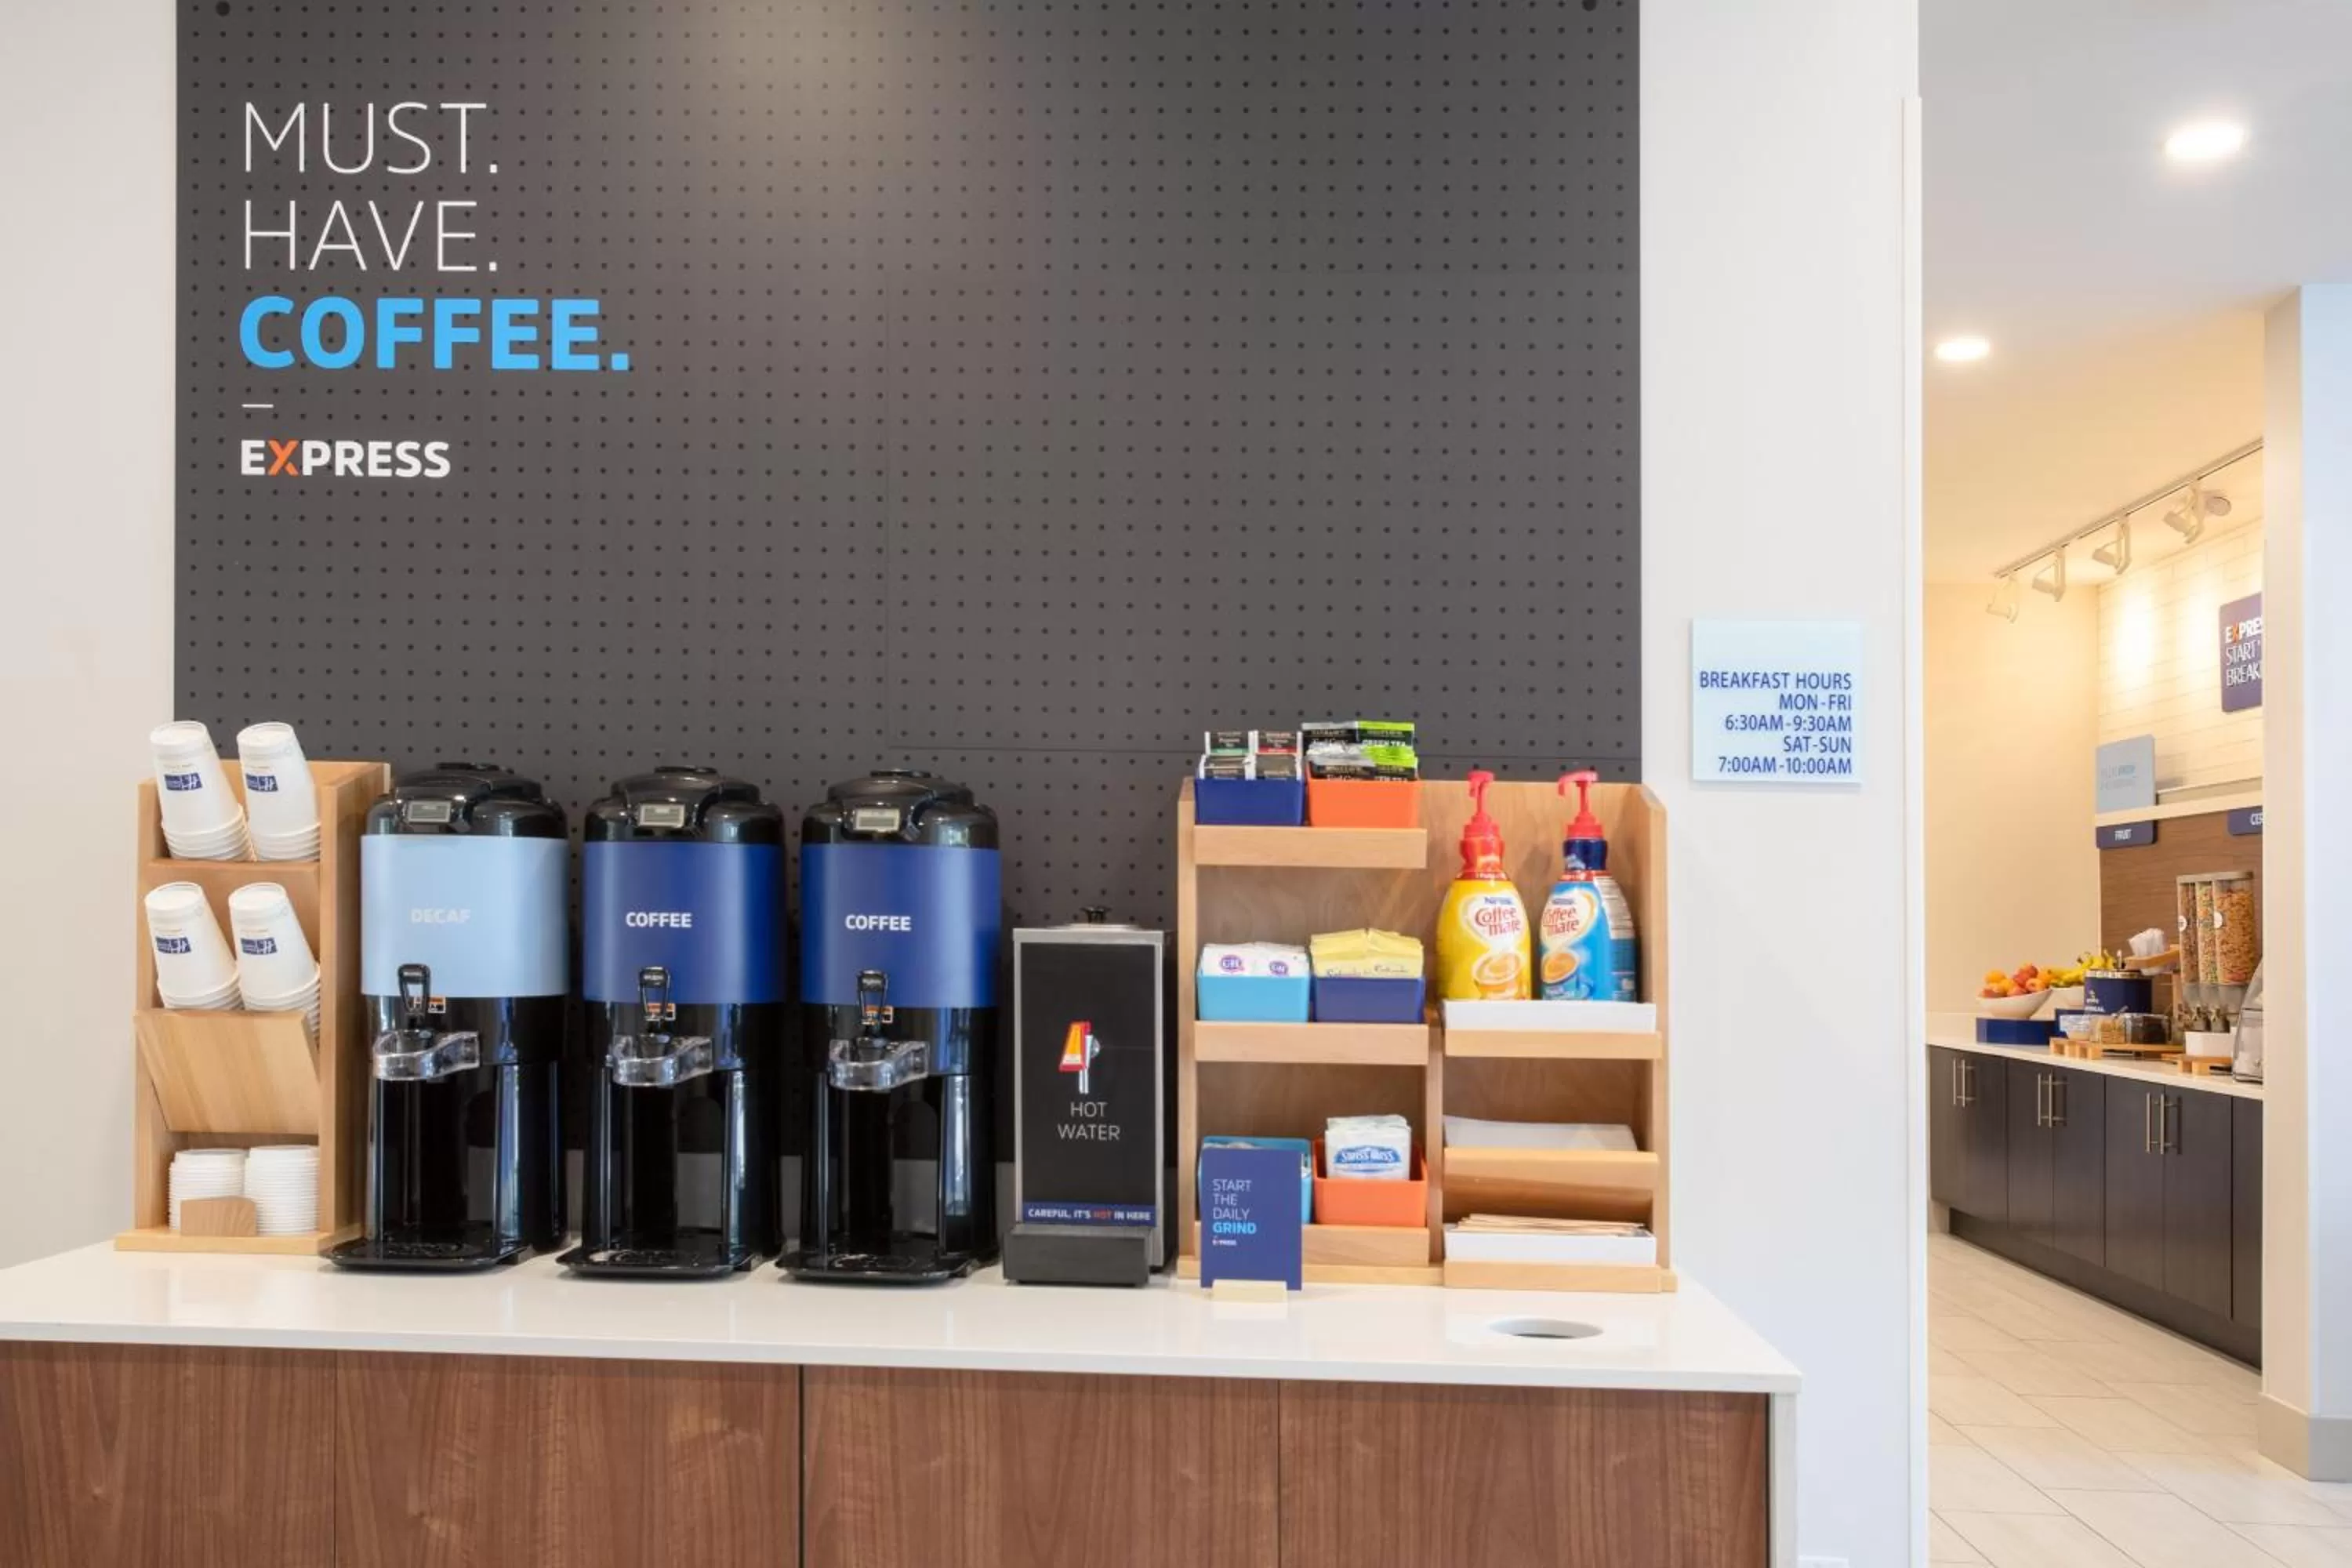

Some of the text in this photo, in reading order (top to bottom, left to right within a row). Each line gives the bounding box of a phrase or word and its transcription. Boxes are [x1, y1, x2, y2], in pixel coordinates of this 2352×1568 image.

[245, 102, 498, 174] MUST.
[245, 200, 497, 271] HAVE.
[239, 295, 630, 370] COFFEE.
[241, 439, 452, 478] EXPRESS
[1699, 670, 1853, 690] BREAKFAST HOURS
[2227, 661, 2262, 686] BREAK
[1783, 735, 1852, 753] SAT-SUN
[411, 909, 470, 924] DECAF
[626, 912, 693, 927] COFFEE
[845, 914, 912, 931] COFFEE
[1070, 1102, 1108, 1117] HOT
[1057, 1123, 1120, 1141] WATER
[1212, 1178, 1253, 1192] START
[1212, 1192, 1239, 1206] THE
[1114, 1210, 1124, 1220] IN
[1126, 1211, 1151, 1221] HERE
[1212, 1207, 1250, 1221] DAILY
[1212, 1221, 1258, 1235] GRIND
